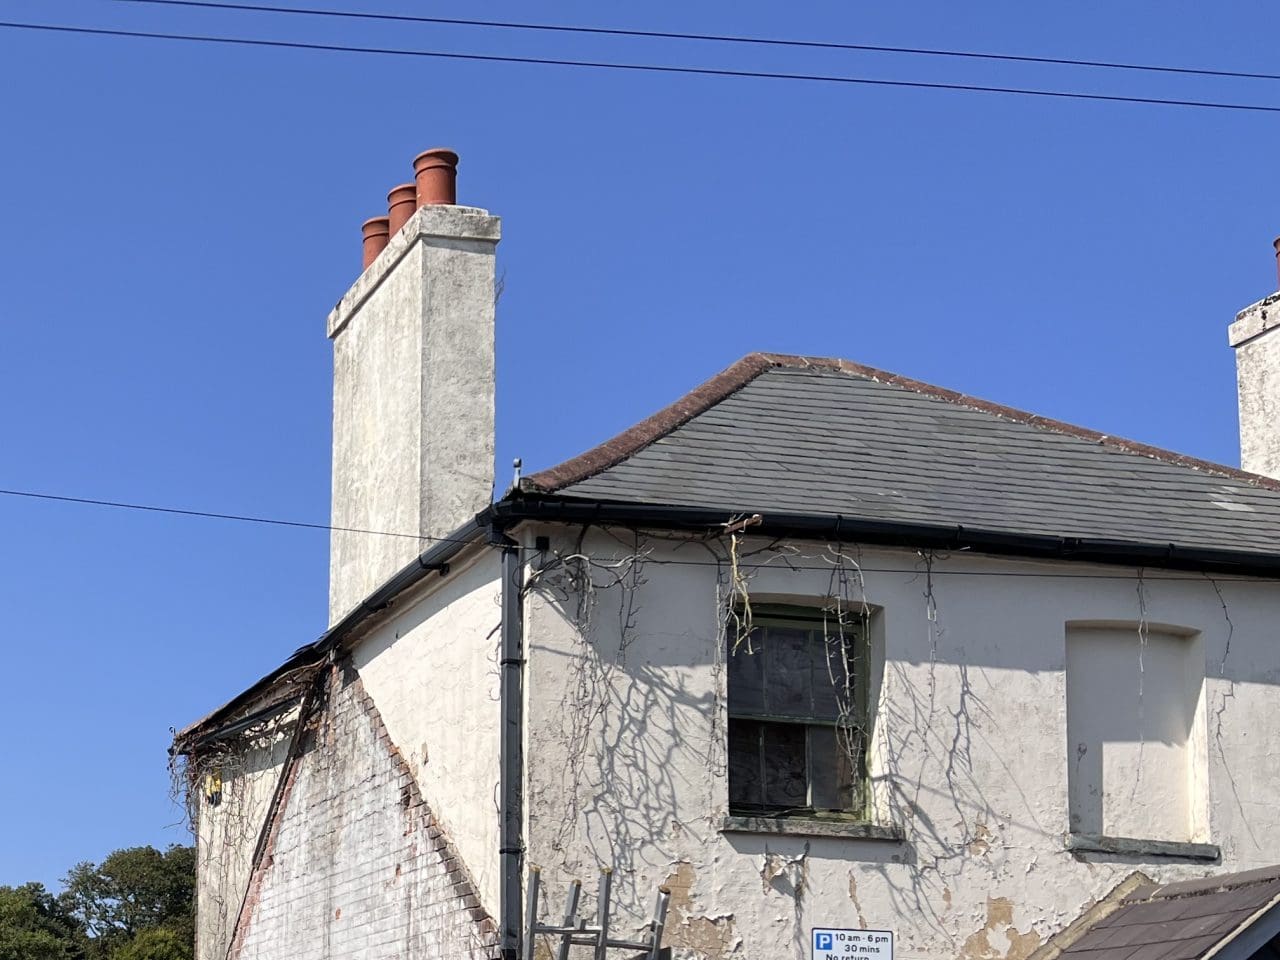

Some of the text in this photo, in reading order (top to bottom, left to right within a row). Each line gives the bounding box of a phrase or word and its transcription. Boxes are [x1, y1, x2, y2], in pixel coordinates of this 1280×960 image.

[820, 935, 830, 949] P
[835, 933, 846, 941] 10
[847, 934, 860, 942] am
[867, 934, 874, 943] 6
[875, 936, 889, 944] pm
[844, 944, 880, 953] 30 mins
[825, 953, 839, 960] No
